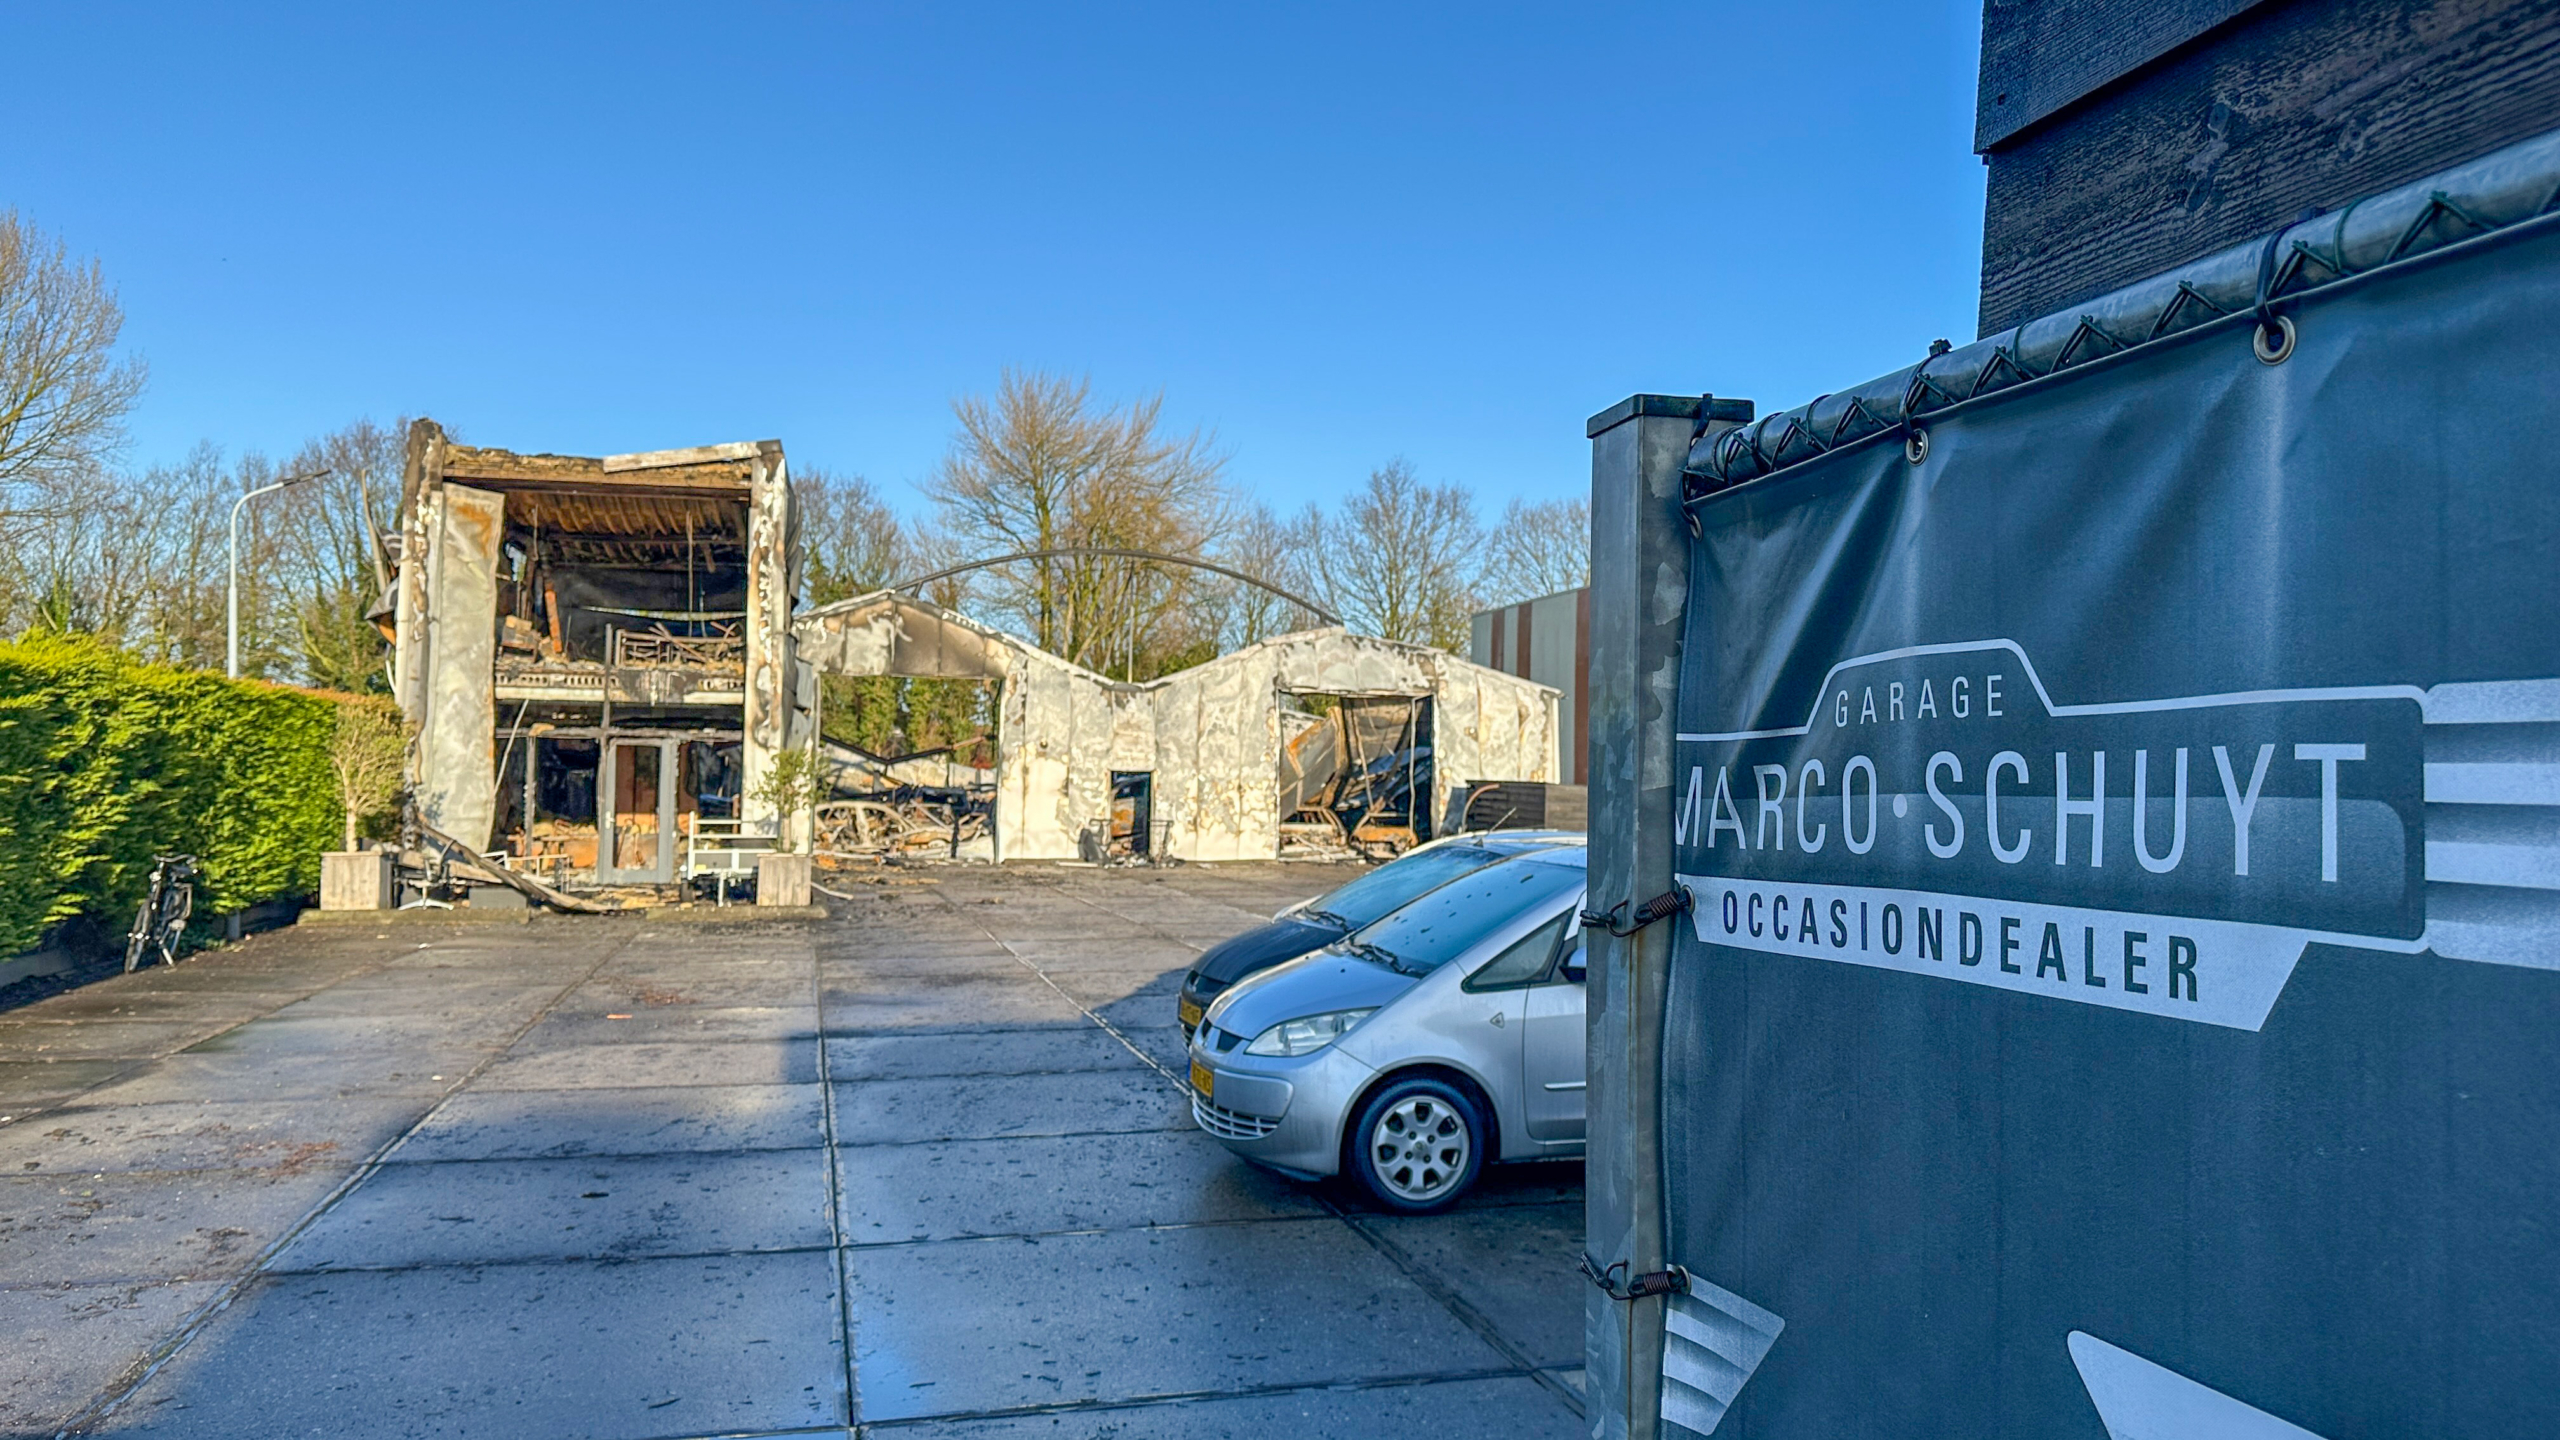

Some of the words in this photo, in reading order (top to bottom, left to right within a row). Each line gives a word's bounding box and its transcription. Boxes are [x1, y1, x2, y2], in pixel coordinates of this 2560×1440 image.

[1835, 675, 2003, 727] GARAGE
[1924, 743, 2366, 882] SCHUYT
[1723, 890, 2198, 1002] OCCASIONDEALER
